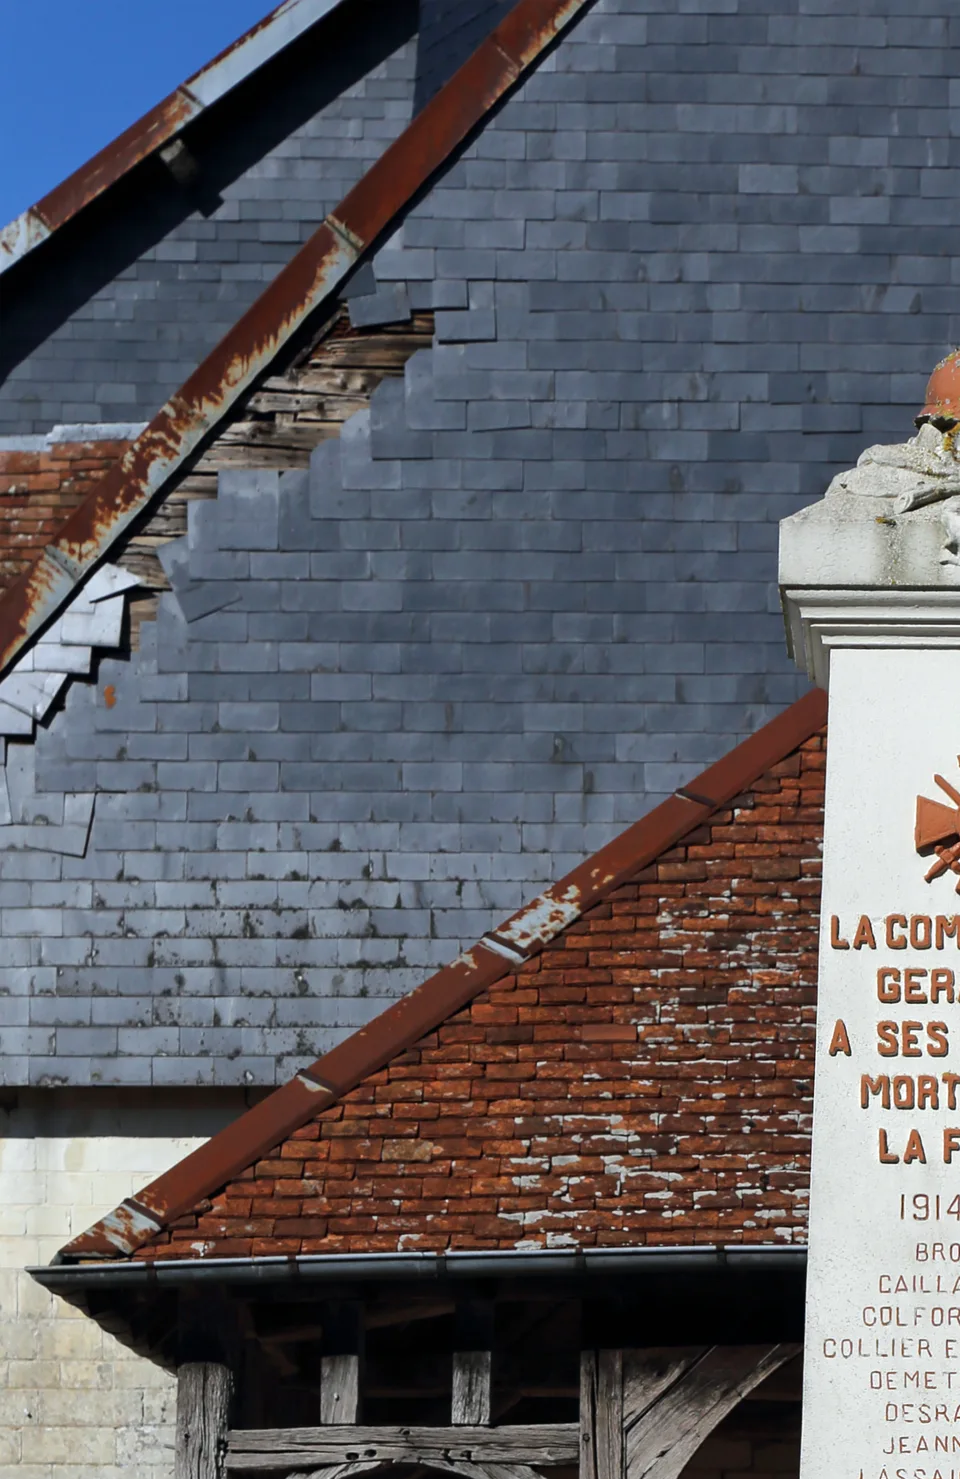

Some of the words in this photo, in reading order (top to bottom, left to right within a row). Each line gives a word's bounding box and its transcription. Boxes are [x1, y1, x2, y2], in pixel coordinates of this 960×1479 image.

[830, 915, 876, 950] LA
[829, 1019, 852, 1057] A
[876, 1020, 949, 1058] SES
[878, 1128, 926, 1164] LA
[822, 1338, 933, 1359] COLLIER
